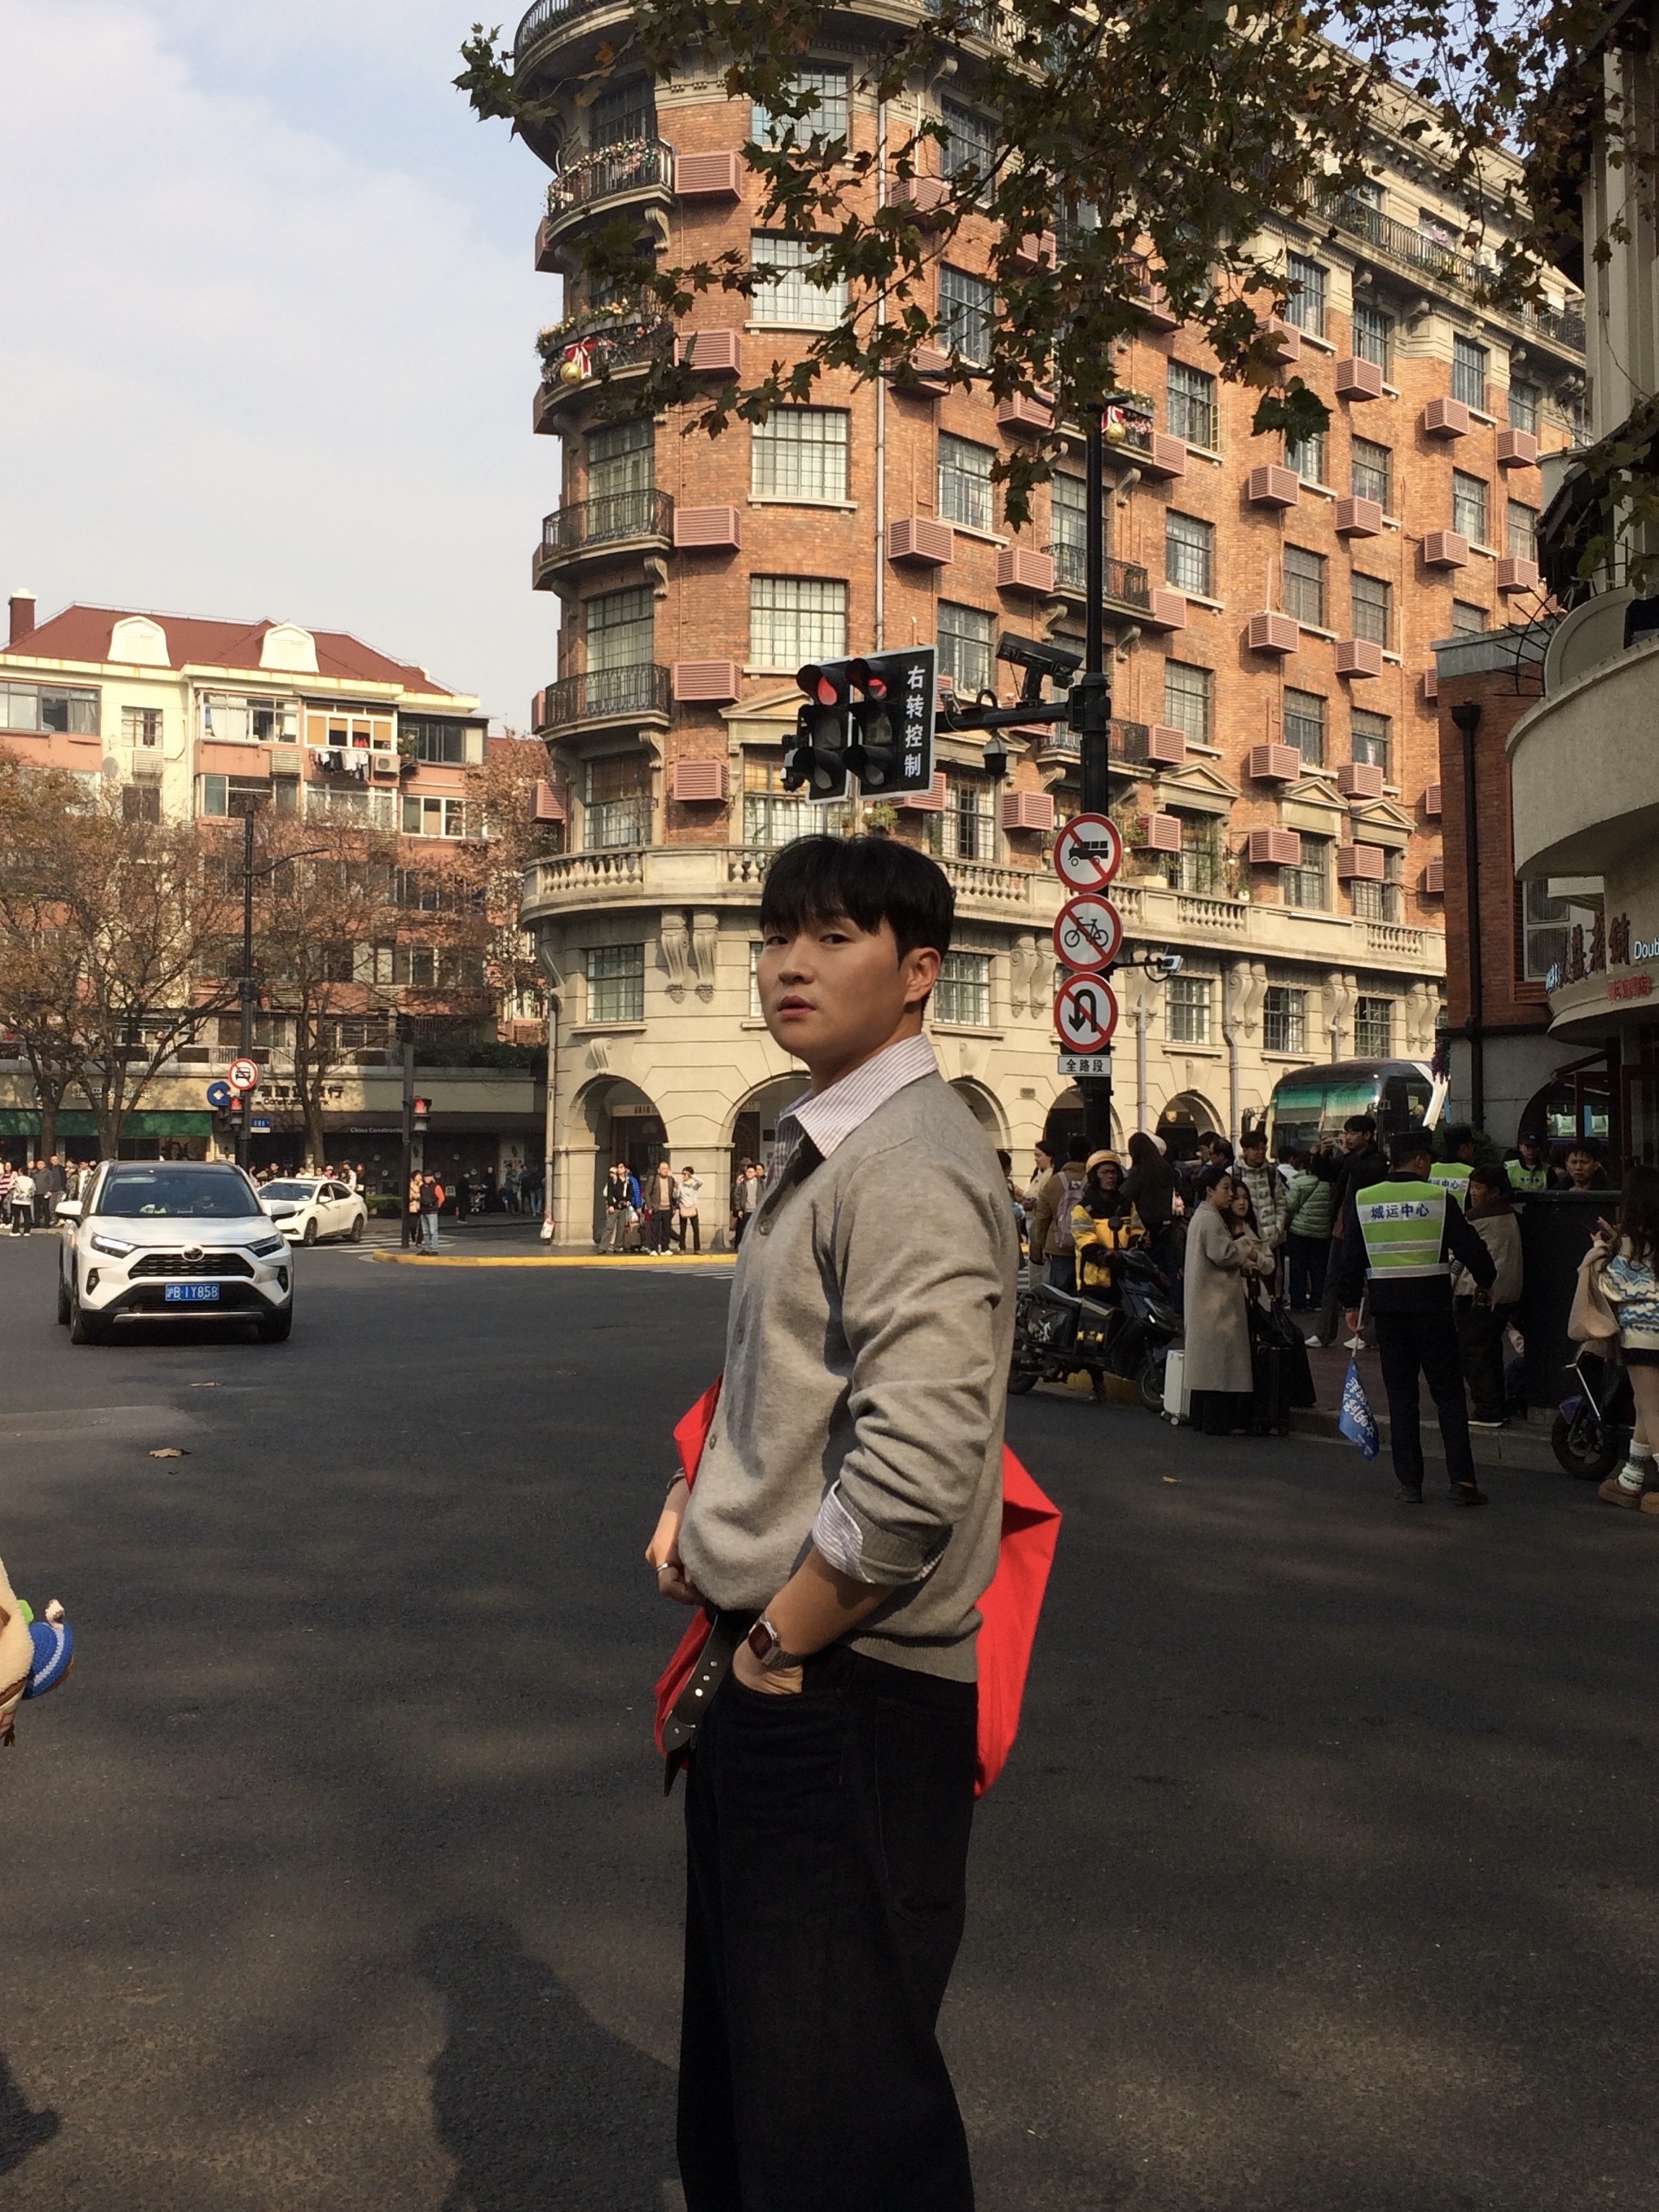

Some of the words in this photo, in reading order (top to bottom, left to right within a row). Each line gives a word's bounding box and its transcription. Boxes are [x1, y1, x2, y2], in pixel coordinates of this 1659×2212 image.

[904, 665, 926, 778] 右转控制
[1066, 1058, 1104, 1072] 全路段
[1371, 1203, 1430, 1220] 城运中心
